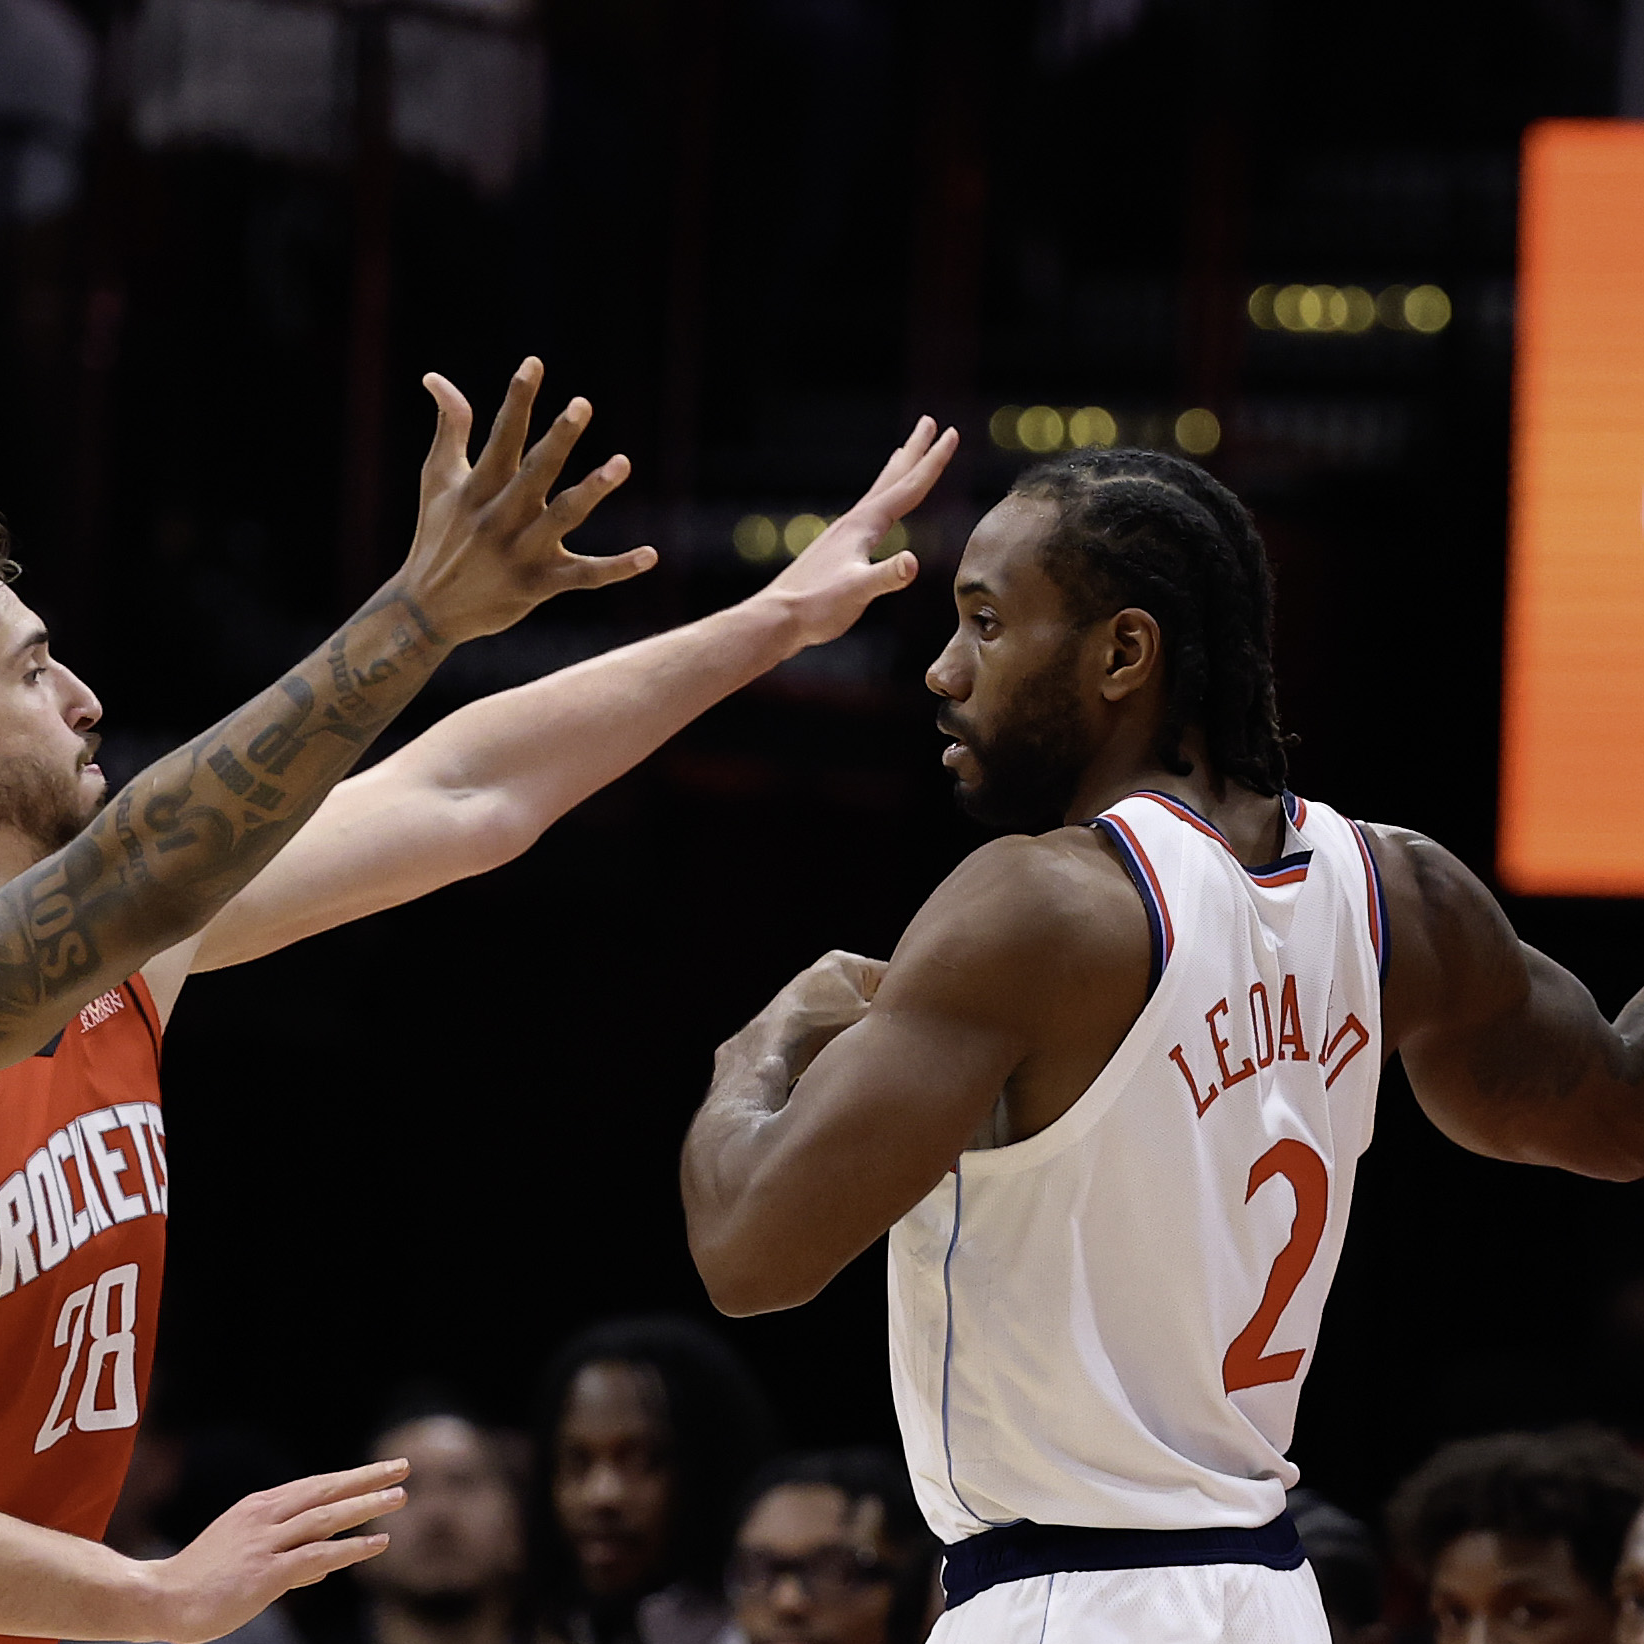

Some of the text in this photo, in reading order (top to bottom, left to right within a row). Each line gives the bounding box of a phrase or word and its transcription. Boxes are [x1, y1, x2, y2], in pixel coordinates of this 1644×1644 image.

[1168, 974, 1370, 1119] LEOAD
[34, 1262, 139, 1454] 28
[1222, 1138, 1329, 1398] 2
